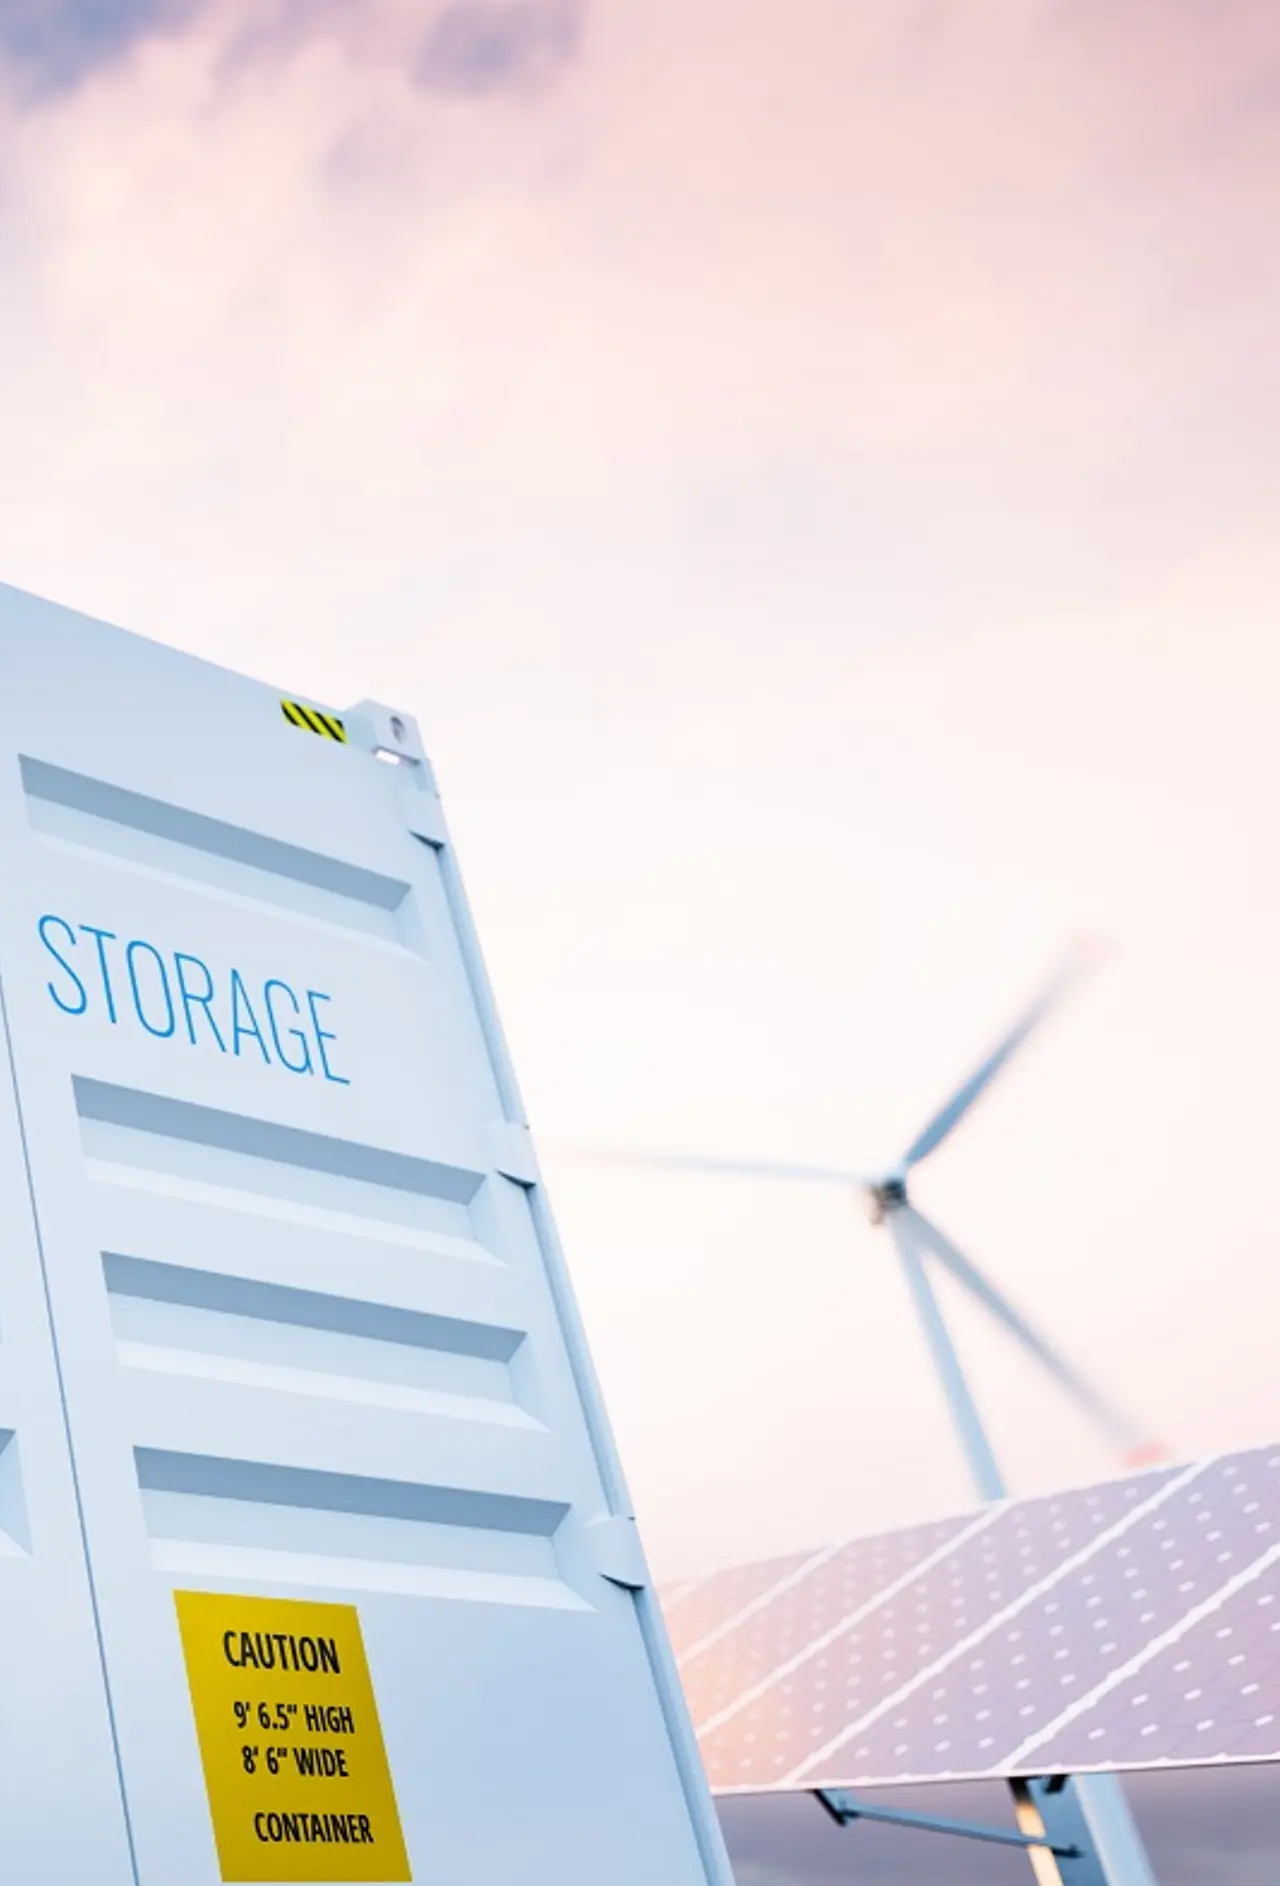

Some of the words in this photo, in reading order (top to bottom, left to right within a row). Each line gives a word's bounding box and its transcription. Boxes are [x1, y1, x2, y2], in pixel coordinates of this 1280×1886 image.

[38, 915, 350, 1085] STORAGE
[223, 1630, 340, 1674] CAUTION
[303, 1704, 355, 1734] HIGH
[292, 1748, 349, 1778] WIDE
[253, 1812, 374, 1843] CONTAINER
